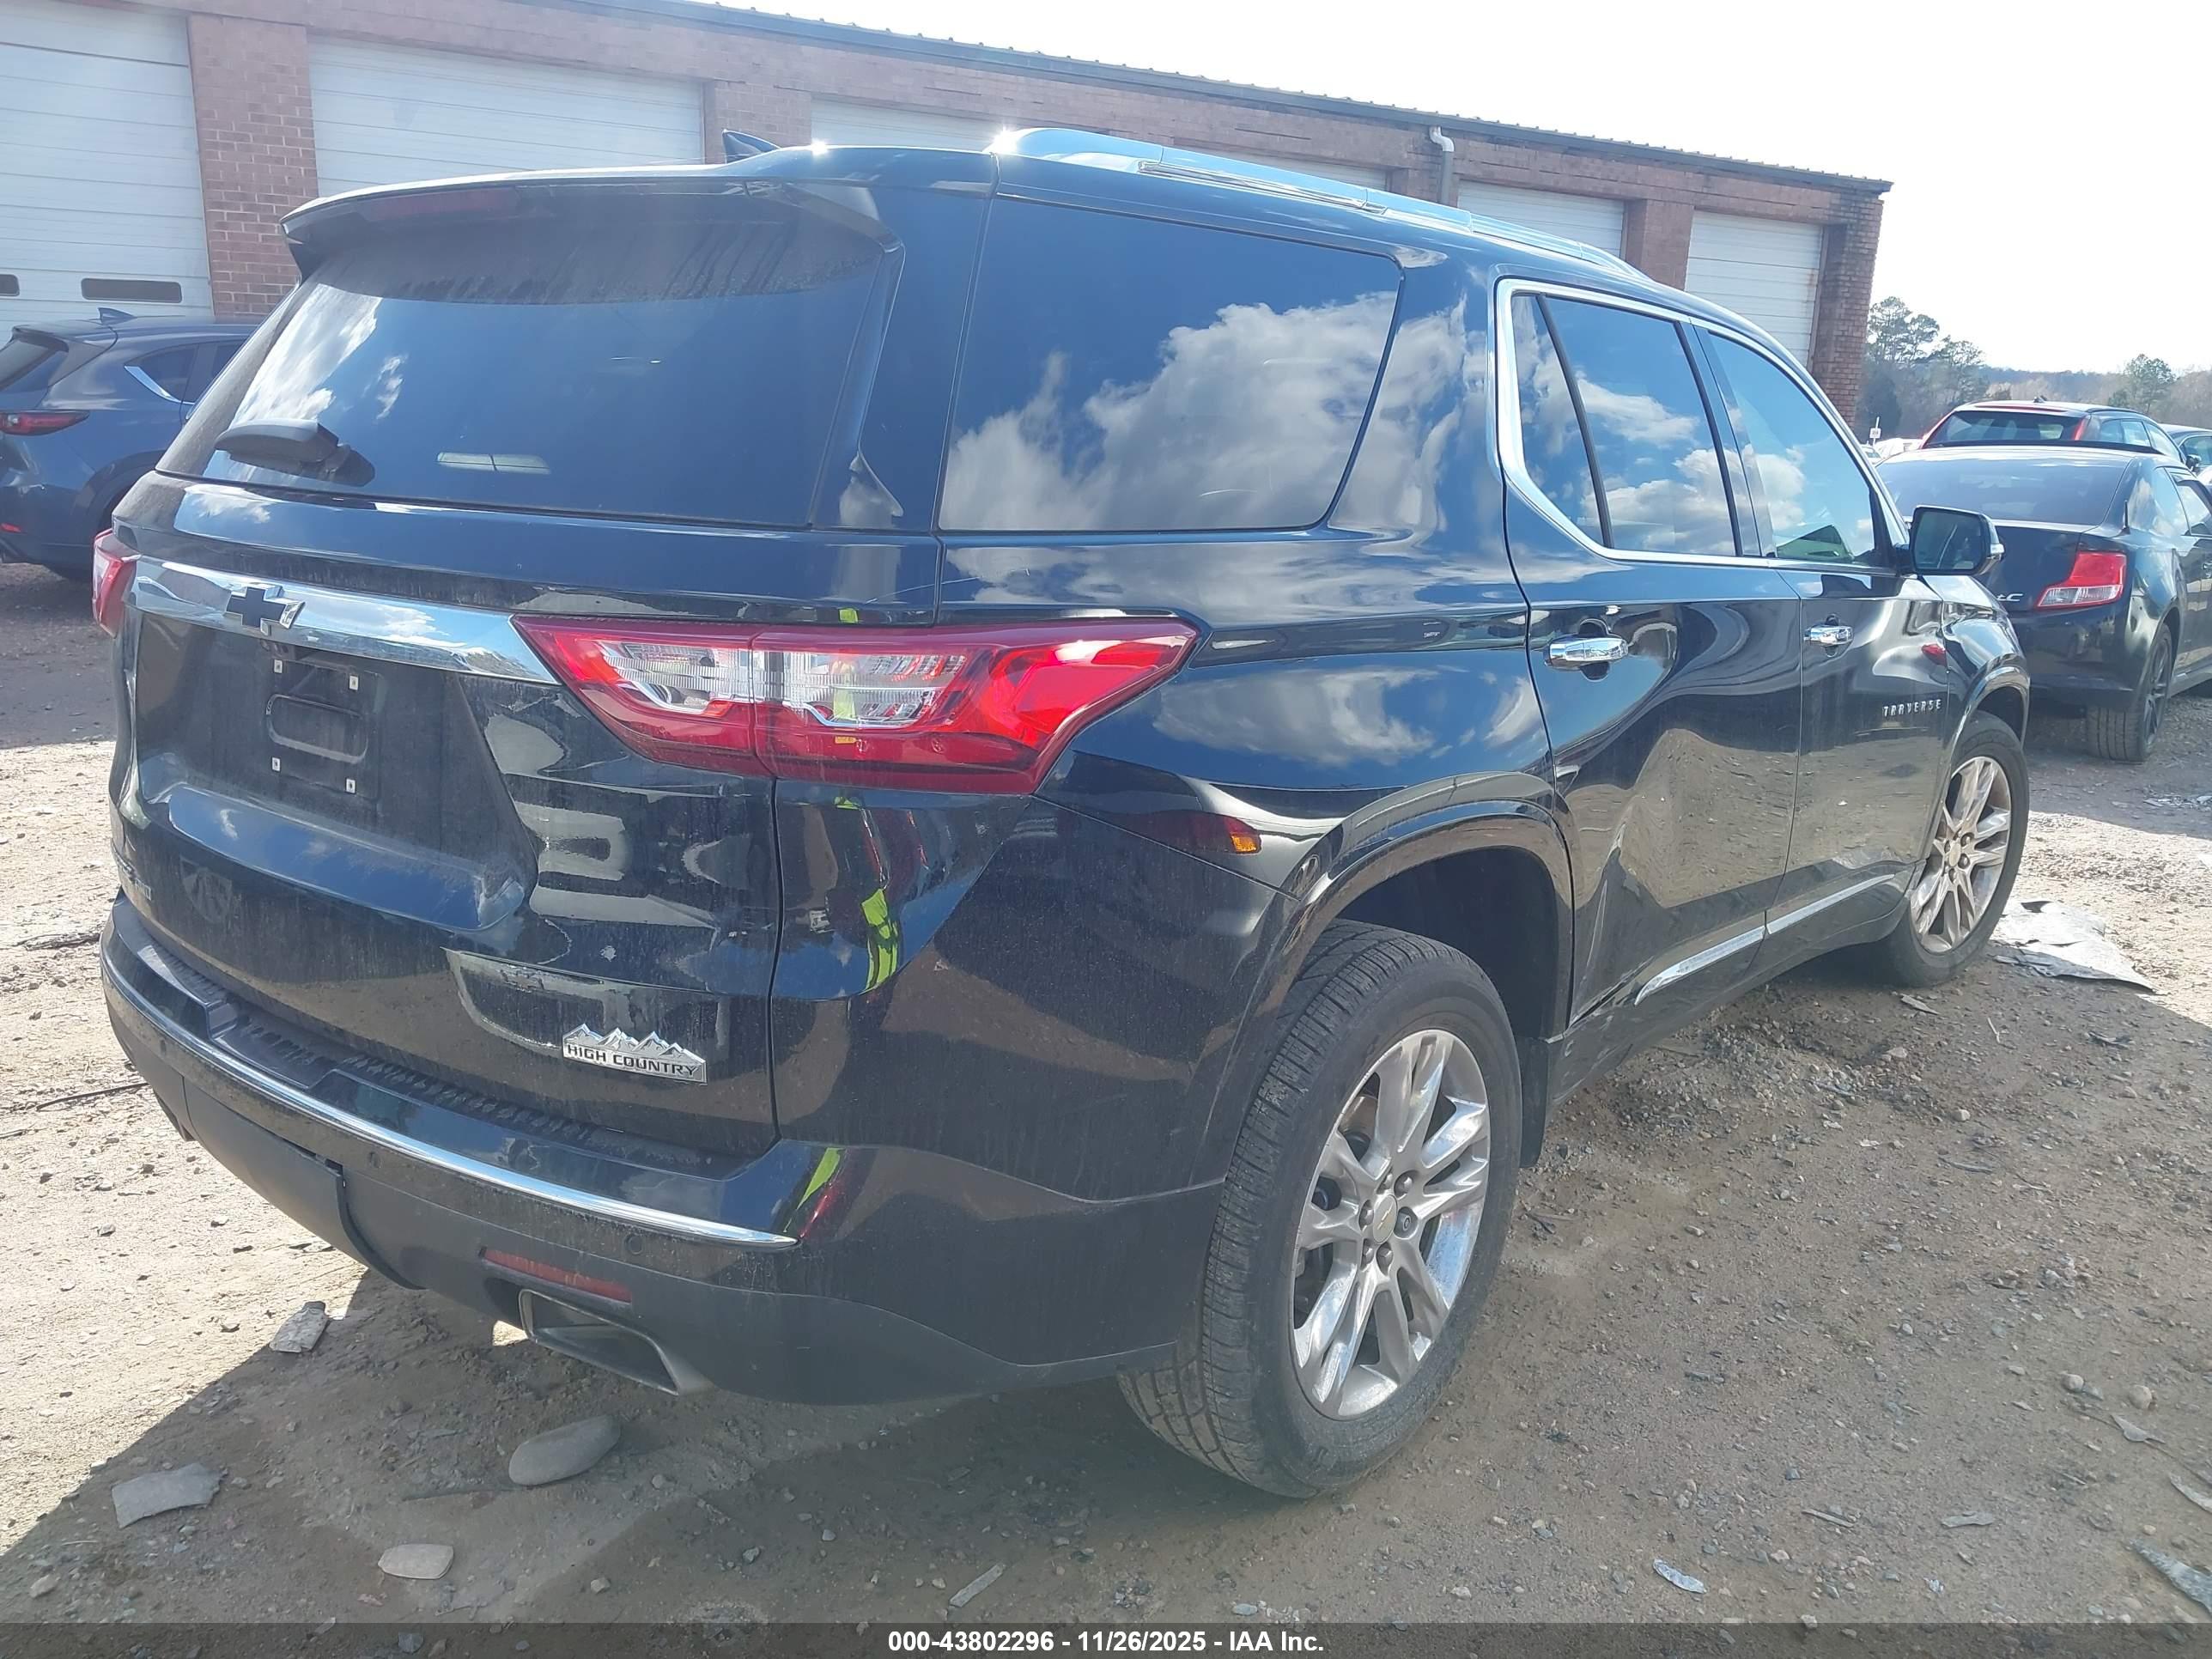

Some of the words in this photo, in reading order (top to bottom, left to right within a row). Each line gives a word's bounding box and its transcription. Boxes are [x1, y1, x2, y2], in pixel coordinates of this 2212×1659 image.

[1883, 699, 1942, 717] TRAVERSE
[568, 1044, 606, 1062] HIGH
[613, 1054, 696, 1076] COUNTRY
